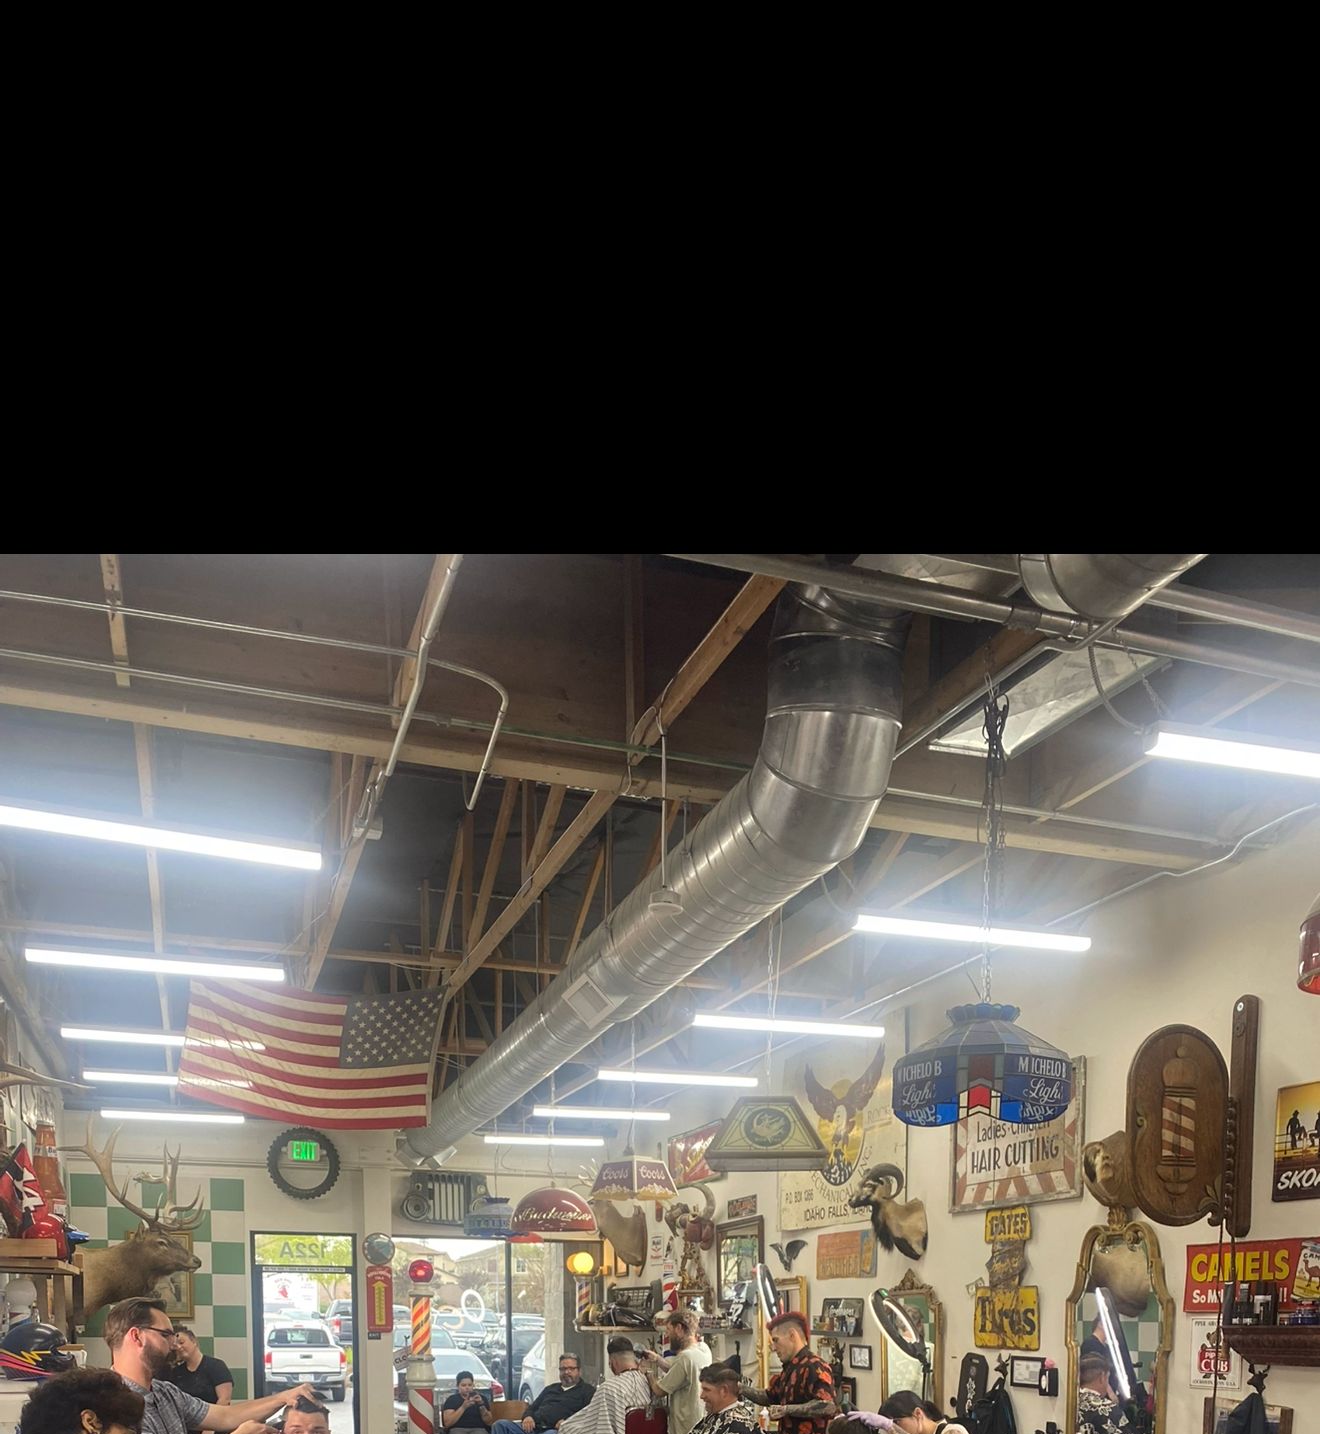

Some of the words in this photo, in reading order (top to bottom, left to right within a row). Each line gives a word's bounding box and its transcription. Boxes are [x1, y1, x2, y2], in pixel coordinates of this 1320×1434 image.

[292, 1141, 317, 1161] EXIT
[971, 1147, 1001, 1174] HAIR
[1004, 1137, 1059, 1167] CUTTING
[602, 1166, 628, 1180] Coors
[639, 1165, 666, 1180] Coors
[811, 1171, 855, 1204] ECHANICAL
[804, 1207, 826, 1221] IDAHO
[990, 1212, 1028, 1236] GATES
[1190, 1249, 1290, 1283] CAMELS
[1192, 1289, 1206, 1304] So
[977, 1296, 1036, 1335] Tires
[1201, 1359, 1228, 1372] CUB
